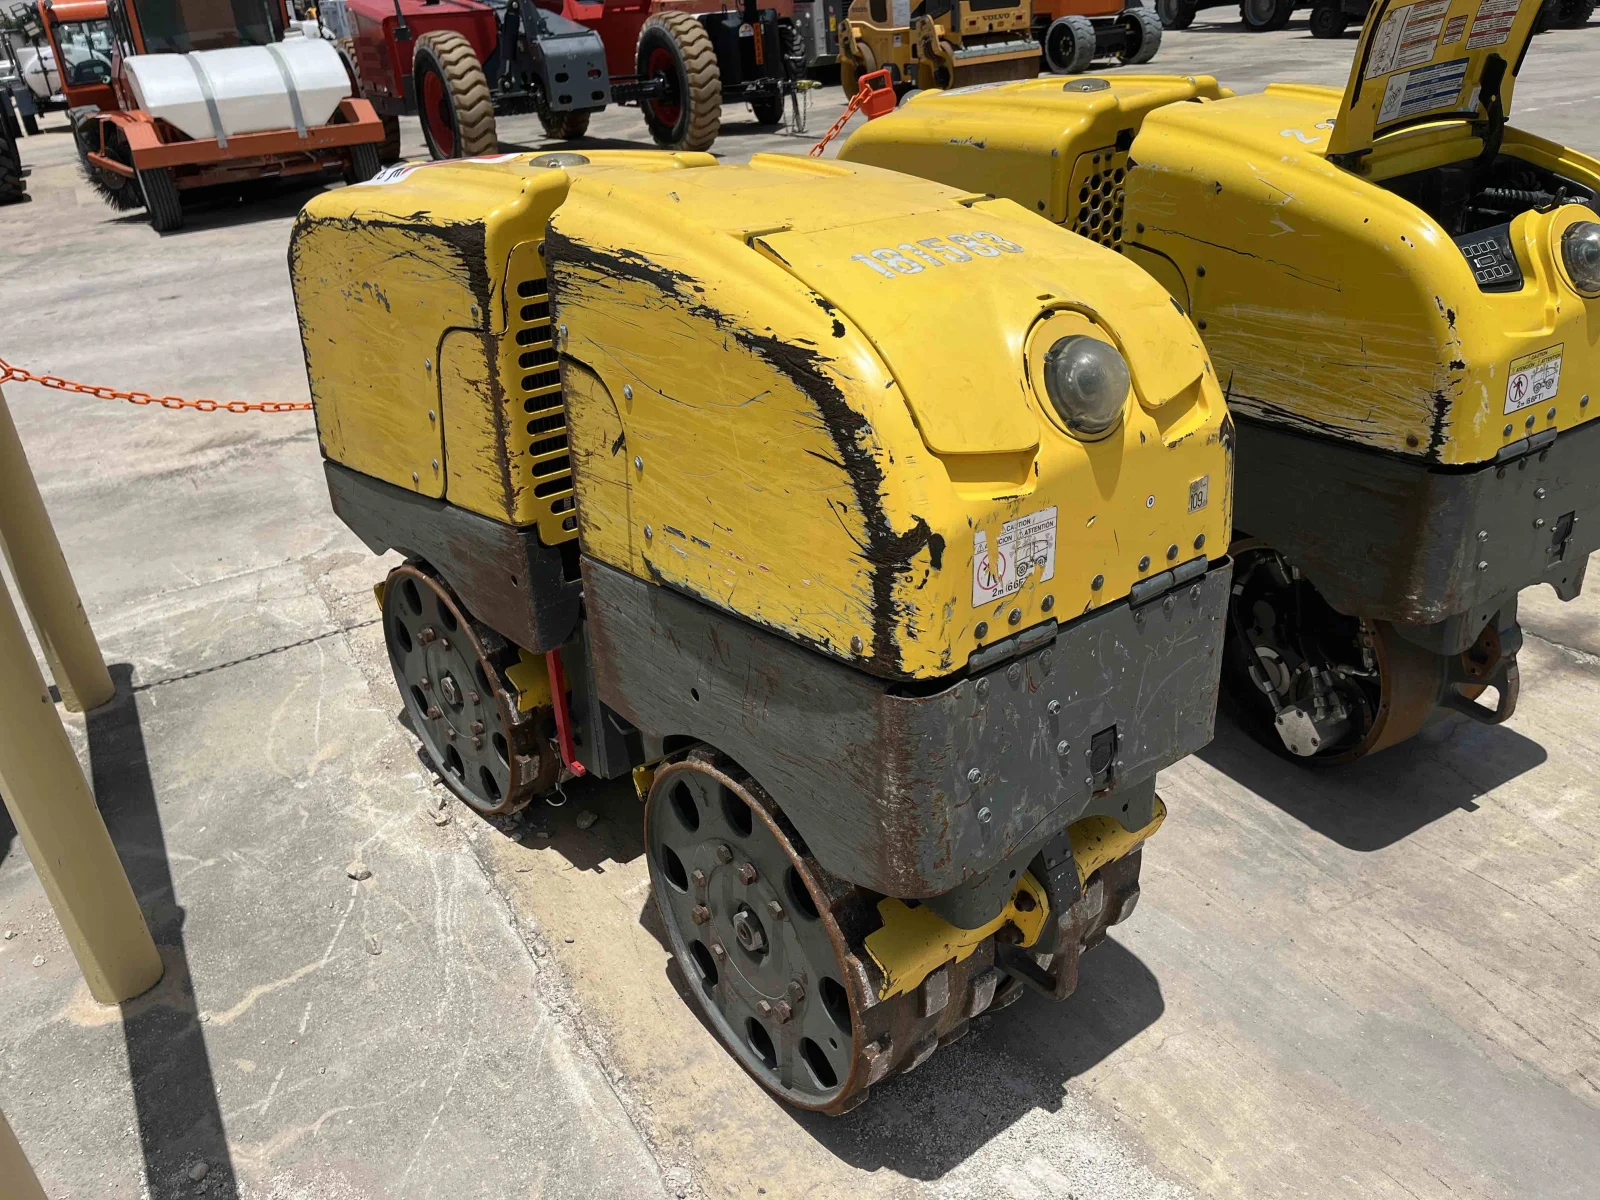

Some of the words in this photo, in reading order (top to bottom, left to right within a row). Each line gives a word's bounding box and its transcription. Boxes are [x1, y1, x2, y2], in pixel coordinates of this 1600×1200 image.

[851, 231, 1025, 278] 181583
[1024, 521, 1054, 535] ATTENTION
[992, 588, 1004, 597] 2m
